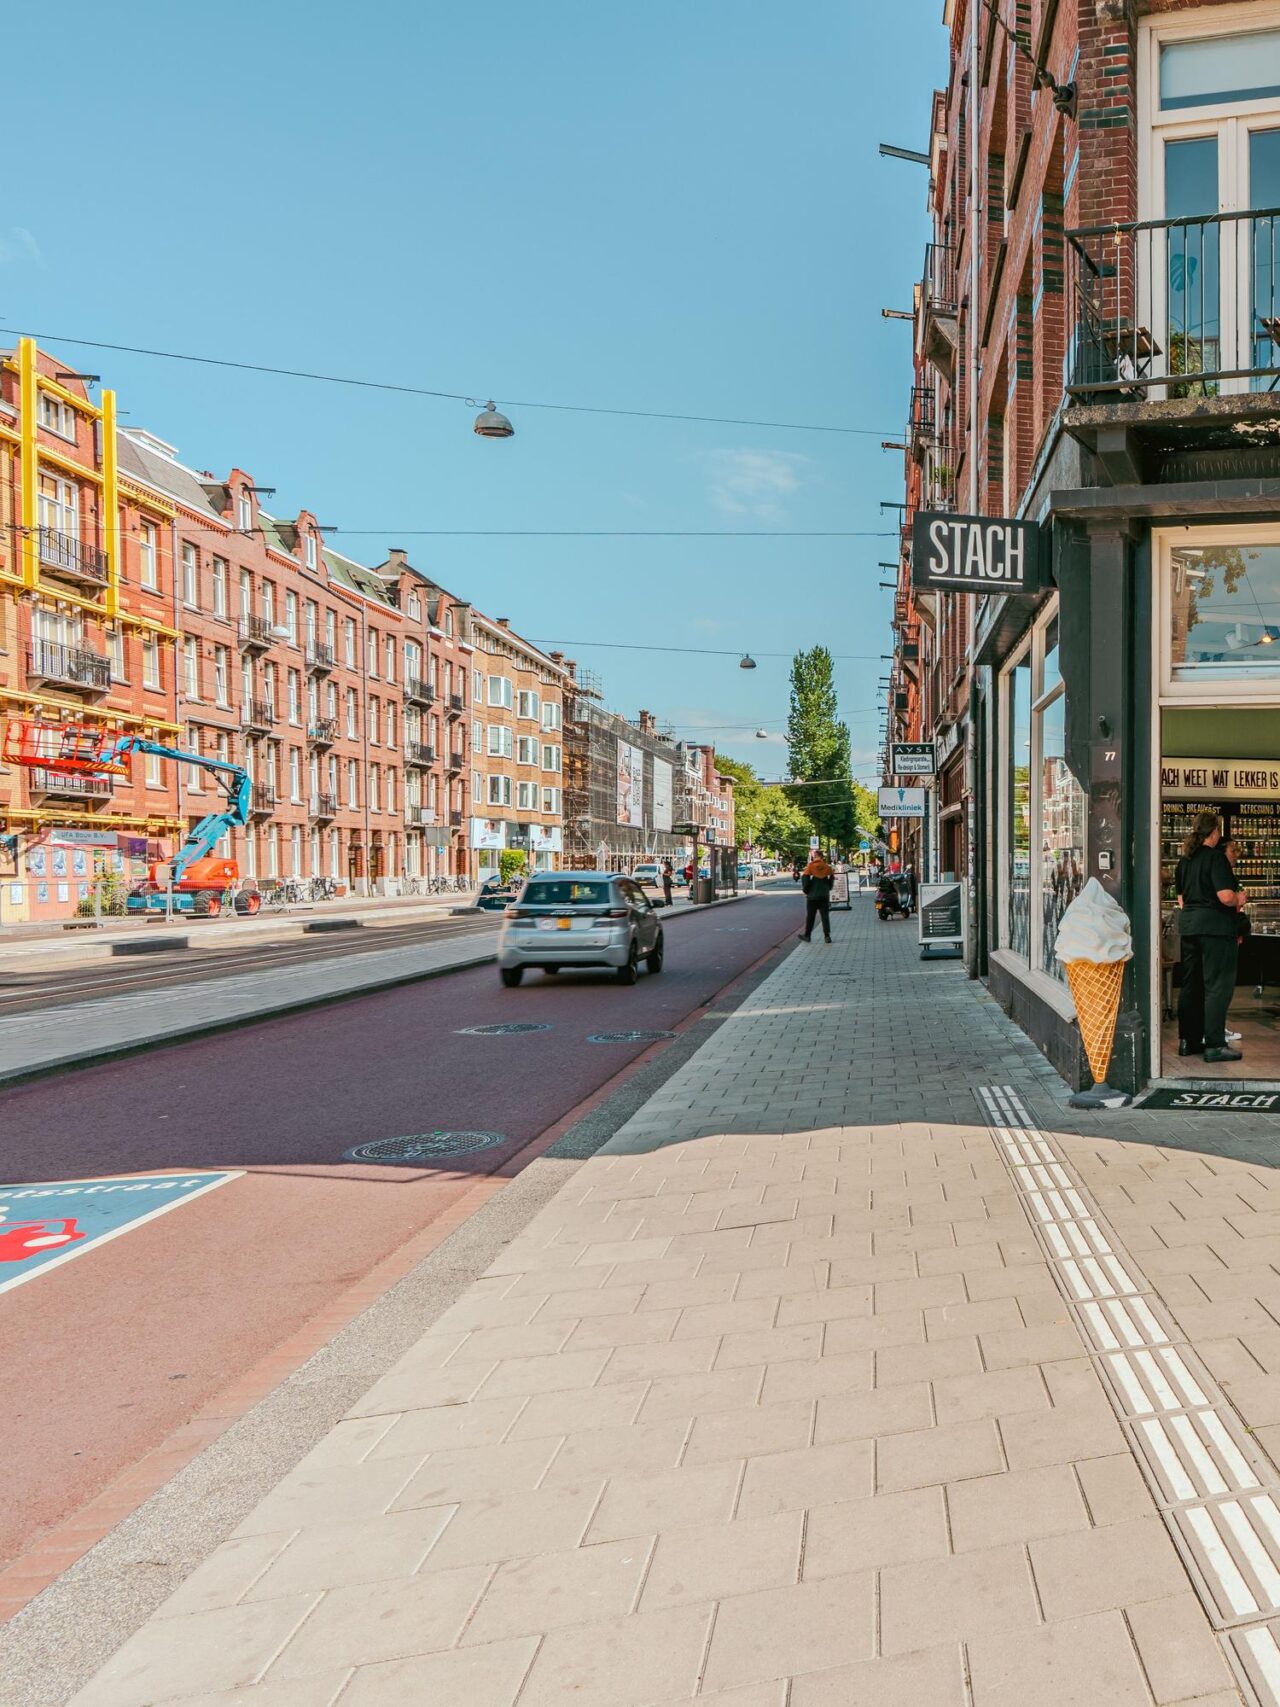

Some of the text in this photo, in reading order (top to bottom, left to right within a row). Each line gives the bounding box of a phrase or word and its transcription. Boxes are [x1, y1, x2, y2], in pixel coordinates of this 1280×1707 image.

[929, 520, 1024, 579] STACH
[1105, 751, 1116, 761] 77
[1161, 768, 1179, 786] ACH
[1183, 769, 1207, 785] WEET
[1212, 770, 1229, 786] WAT
[1234, 771, 1266, 787] LEKKER
[1270, 772, 1278, 787] IS
[1174, 1093, 1279, 1107] STACH
